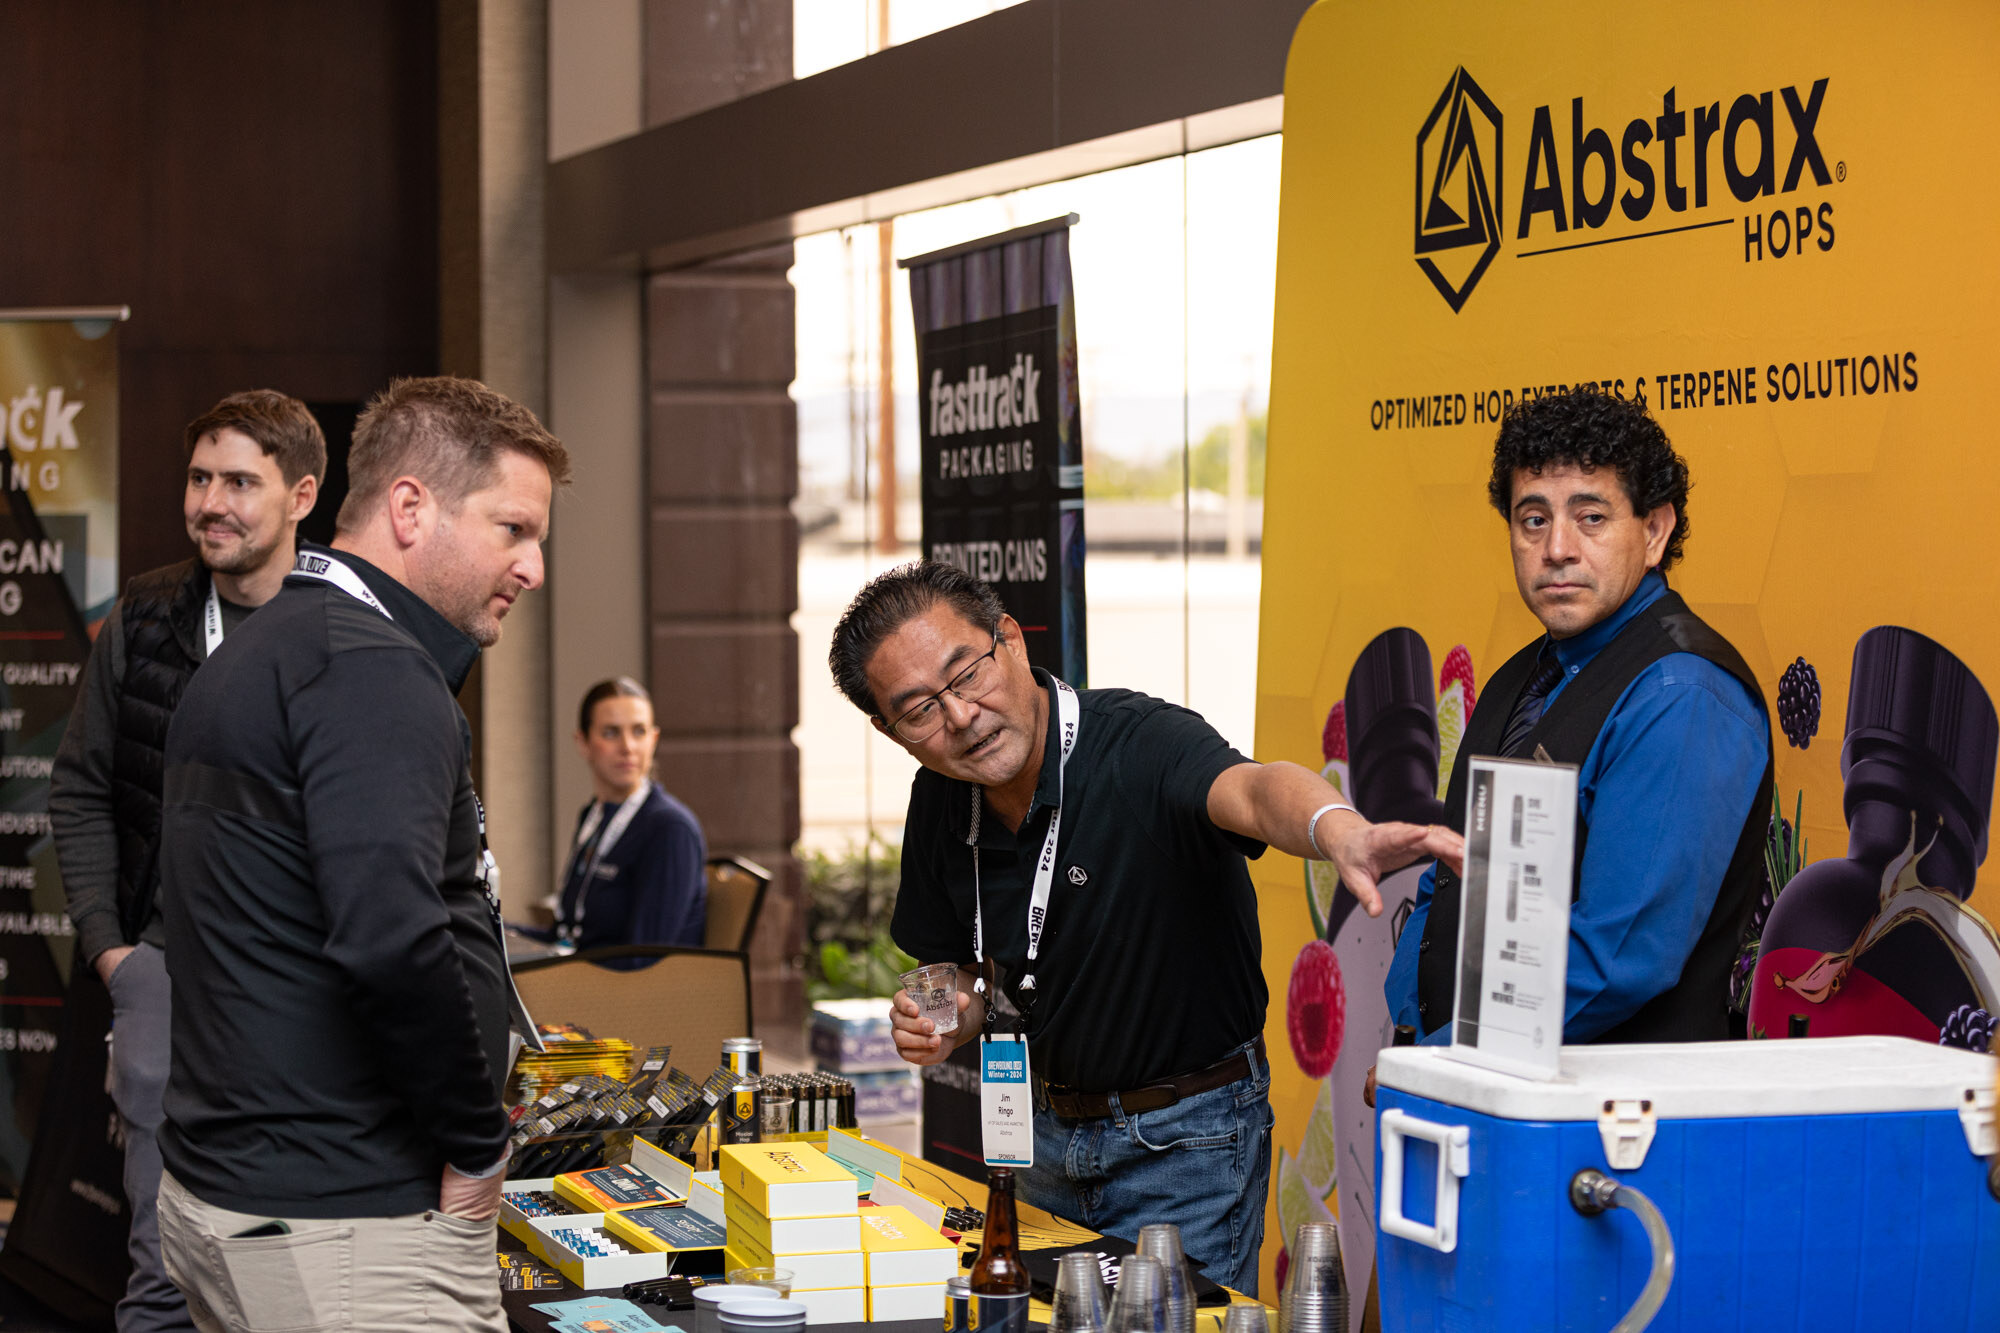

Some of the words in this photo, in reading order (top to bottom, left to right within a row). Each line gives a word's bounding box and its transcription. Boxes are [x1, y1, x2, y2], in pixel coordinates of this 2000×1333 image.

[1744, 202, 1836, 263] HOPS
[929, 353, 1041, 437] fasttrack
[1370, 393, 1467, 431] OPTIMIZED
[1473, 388, 1514, 424] HOP
[1656, 366, 1757, 411] TERPENE
[1766, 351, 1919, 402] SOLUTIONS
[940, 439, 1034, 480] PACKAGING
[0, 539, 64, 575] CAN
[1004, 538, 1048, 582] CANS
[3, 661, 82, 686] QUALITY
[1062, 722, 1074, 755] 2024
[1475, 784, 1488, 832] MENU
[1041, 838, 1054, 872] 2024
[987, 1070, 1006, 1079] Winter
[1009, 1070, 1023, 1079] 2024
[998, 1106, 1014, 1118] Ringo
[1001, 1093, 1011, 1102] Jim
